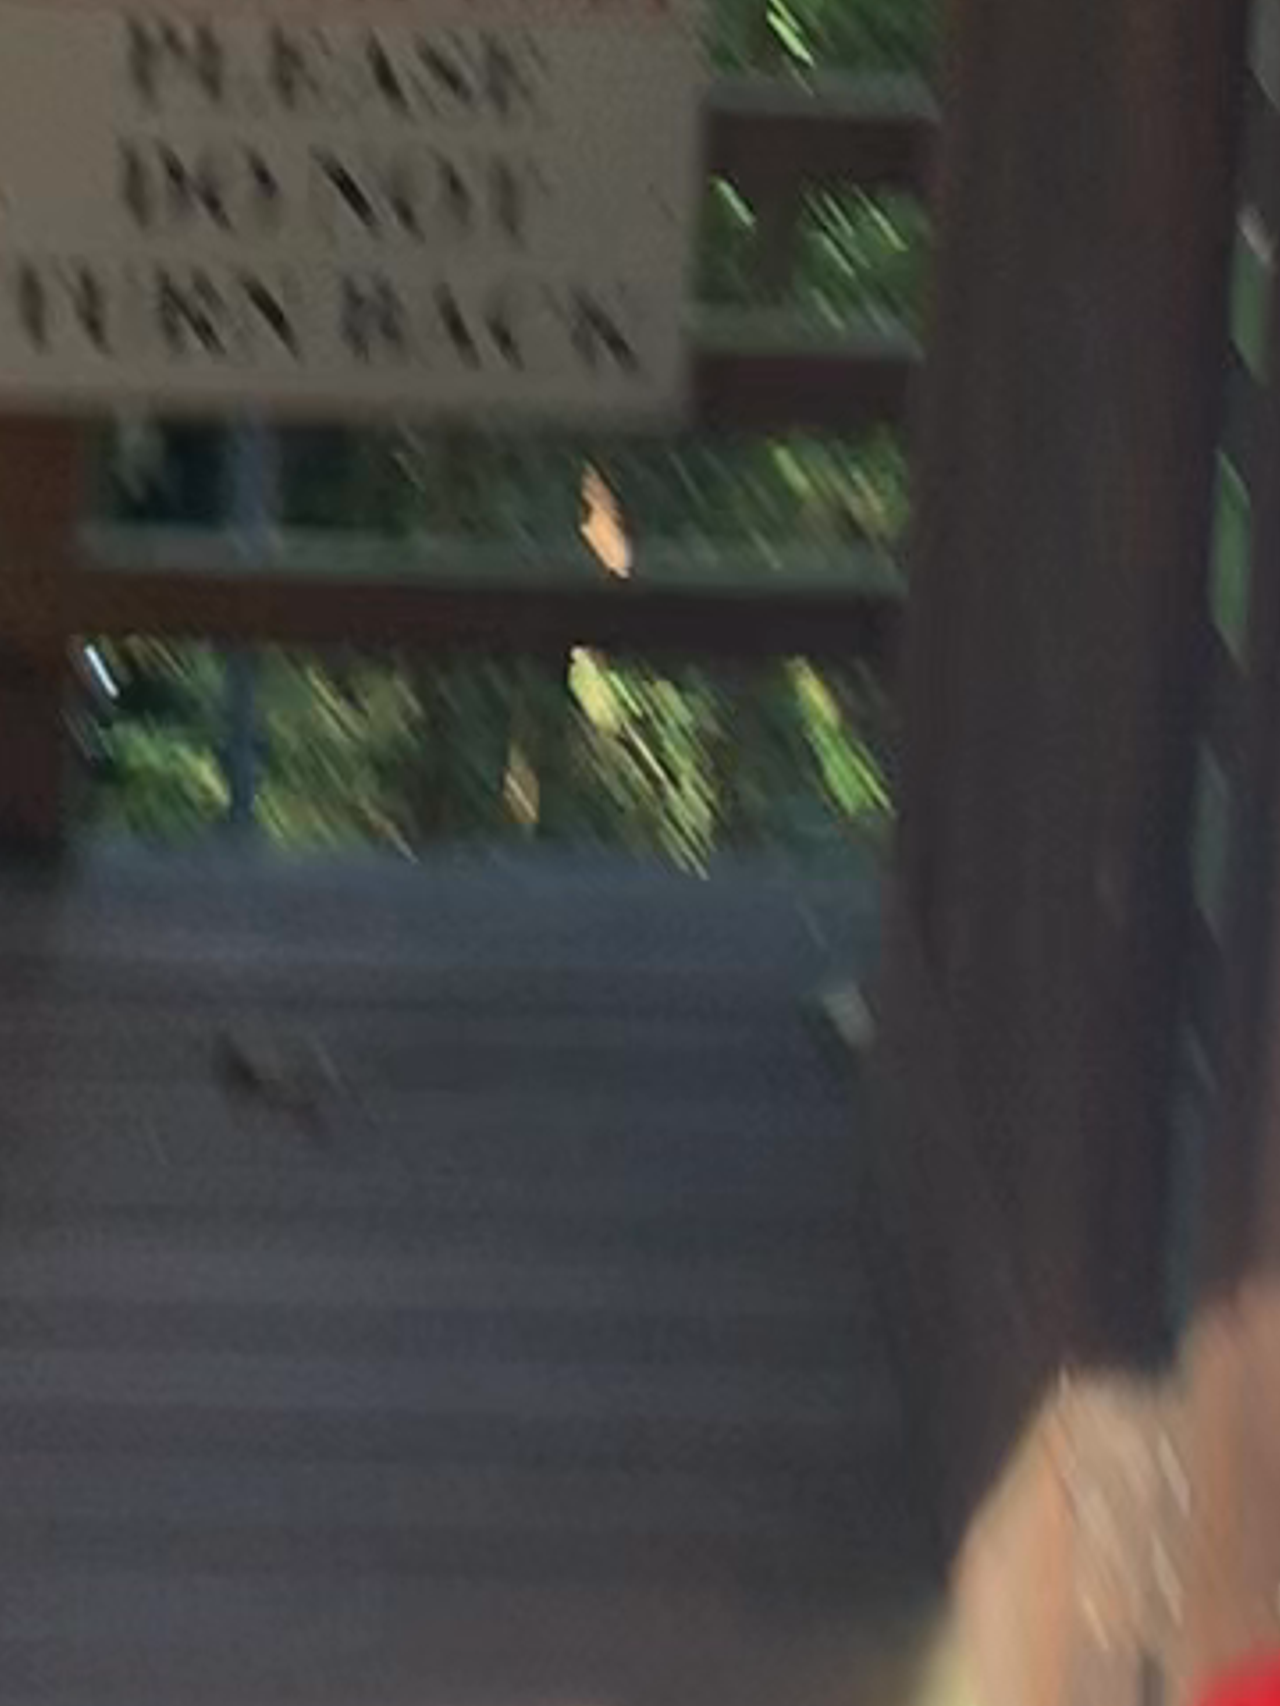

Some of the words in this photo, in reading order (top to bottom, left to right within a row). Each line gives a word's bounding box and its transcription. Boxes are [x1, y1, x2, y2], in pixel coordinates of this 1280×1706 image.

[120, 11, 552, 120] PLEASE
[116, 138, 292, 232] DO
[308, 142, 556, 250] NOT
[2, 252, 312, 362] TURN
[334, 266, 650, 378] BACK
